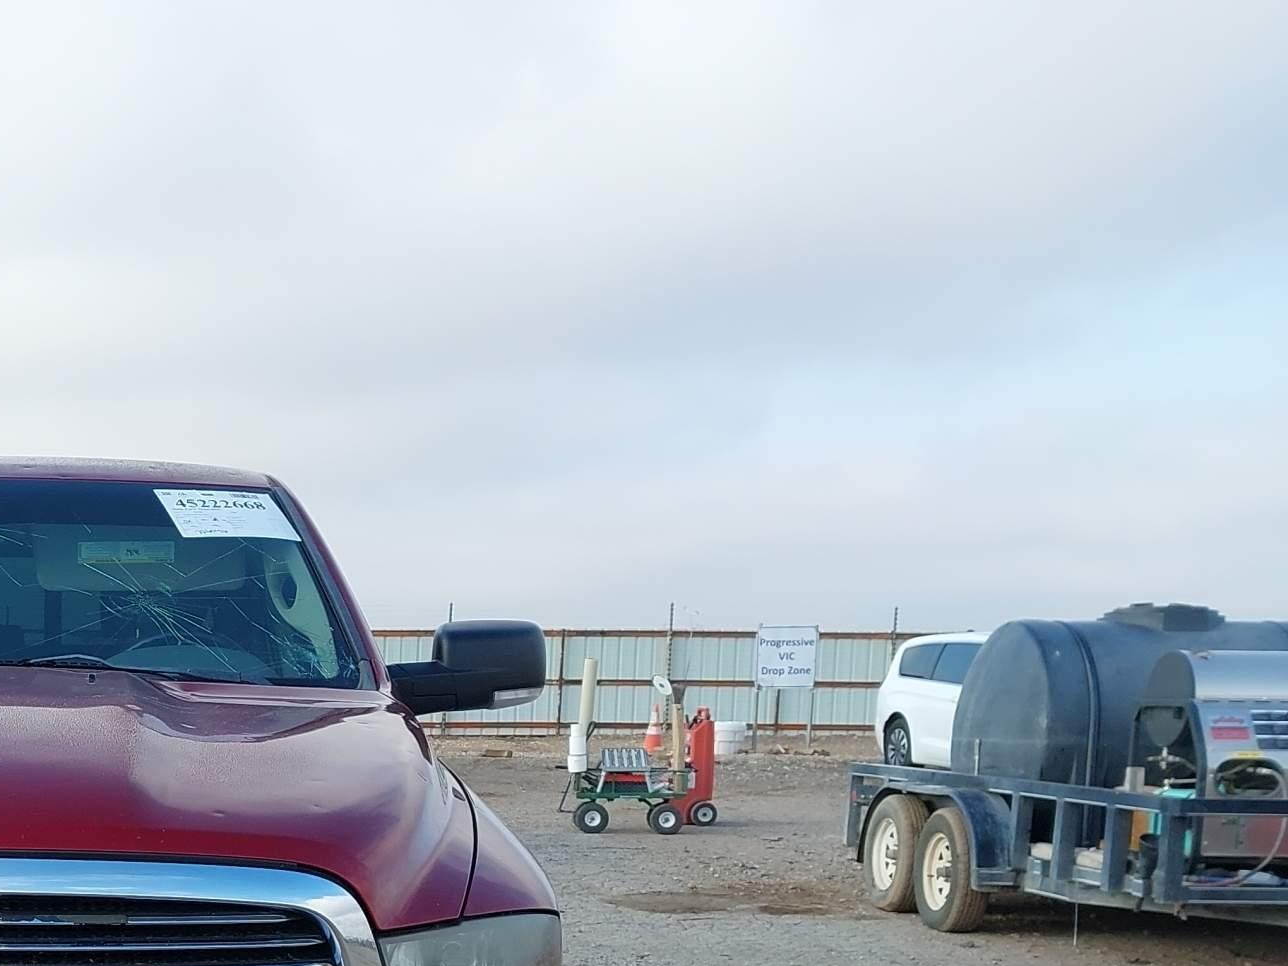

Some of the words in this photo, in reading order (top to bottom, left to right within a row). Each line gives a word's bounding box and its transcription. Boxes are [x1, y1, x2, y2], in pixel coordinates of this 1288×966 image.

[175, 498, 267, 511] 45222668
[759, 637, 815, 648] Progressive
[778, 652, 796, 661] VIC
[761, 666, 785, 677] Drop
[787, 666, 812, 675] Zone
